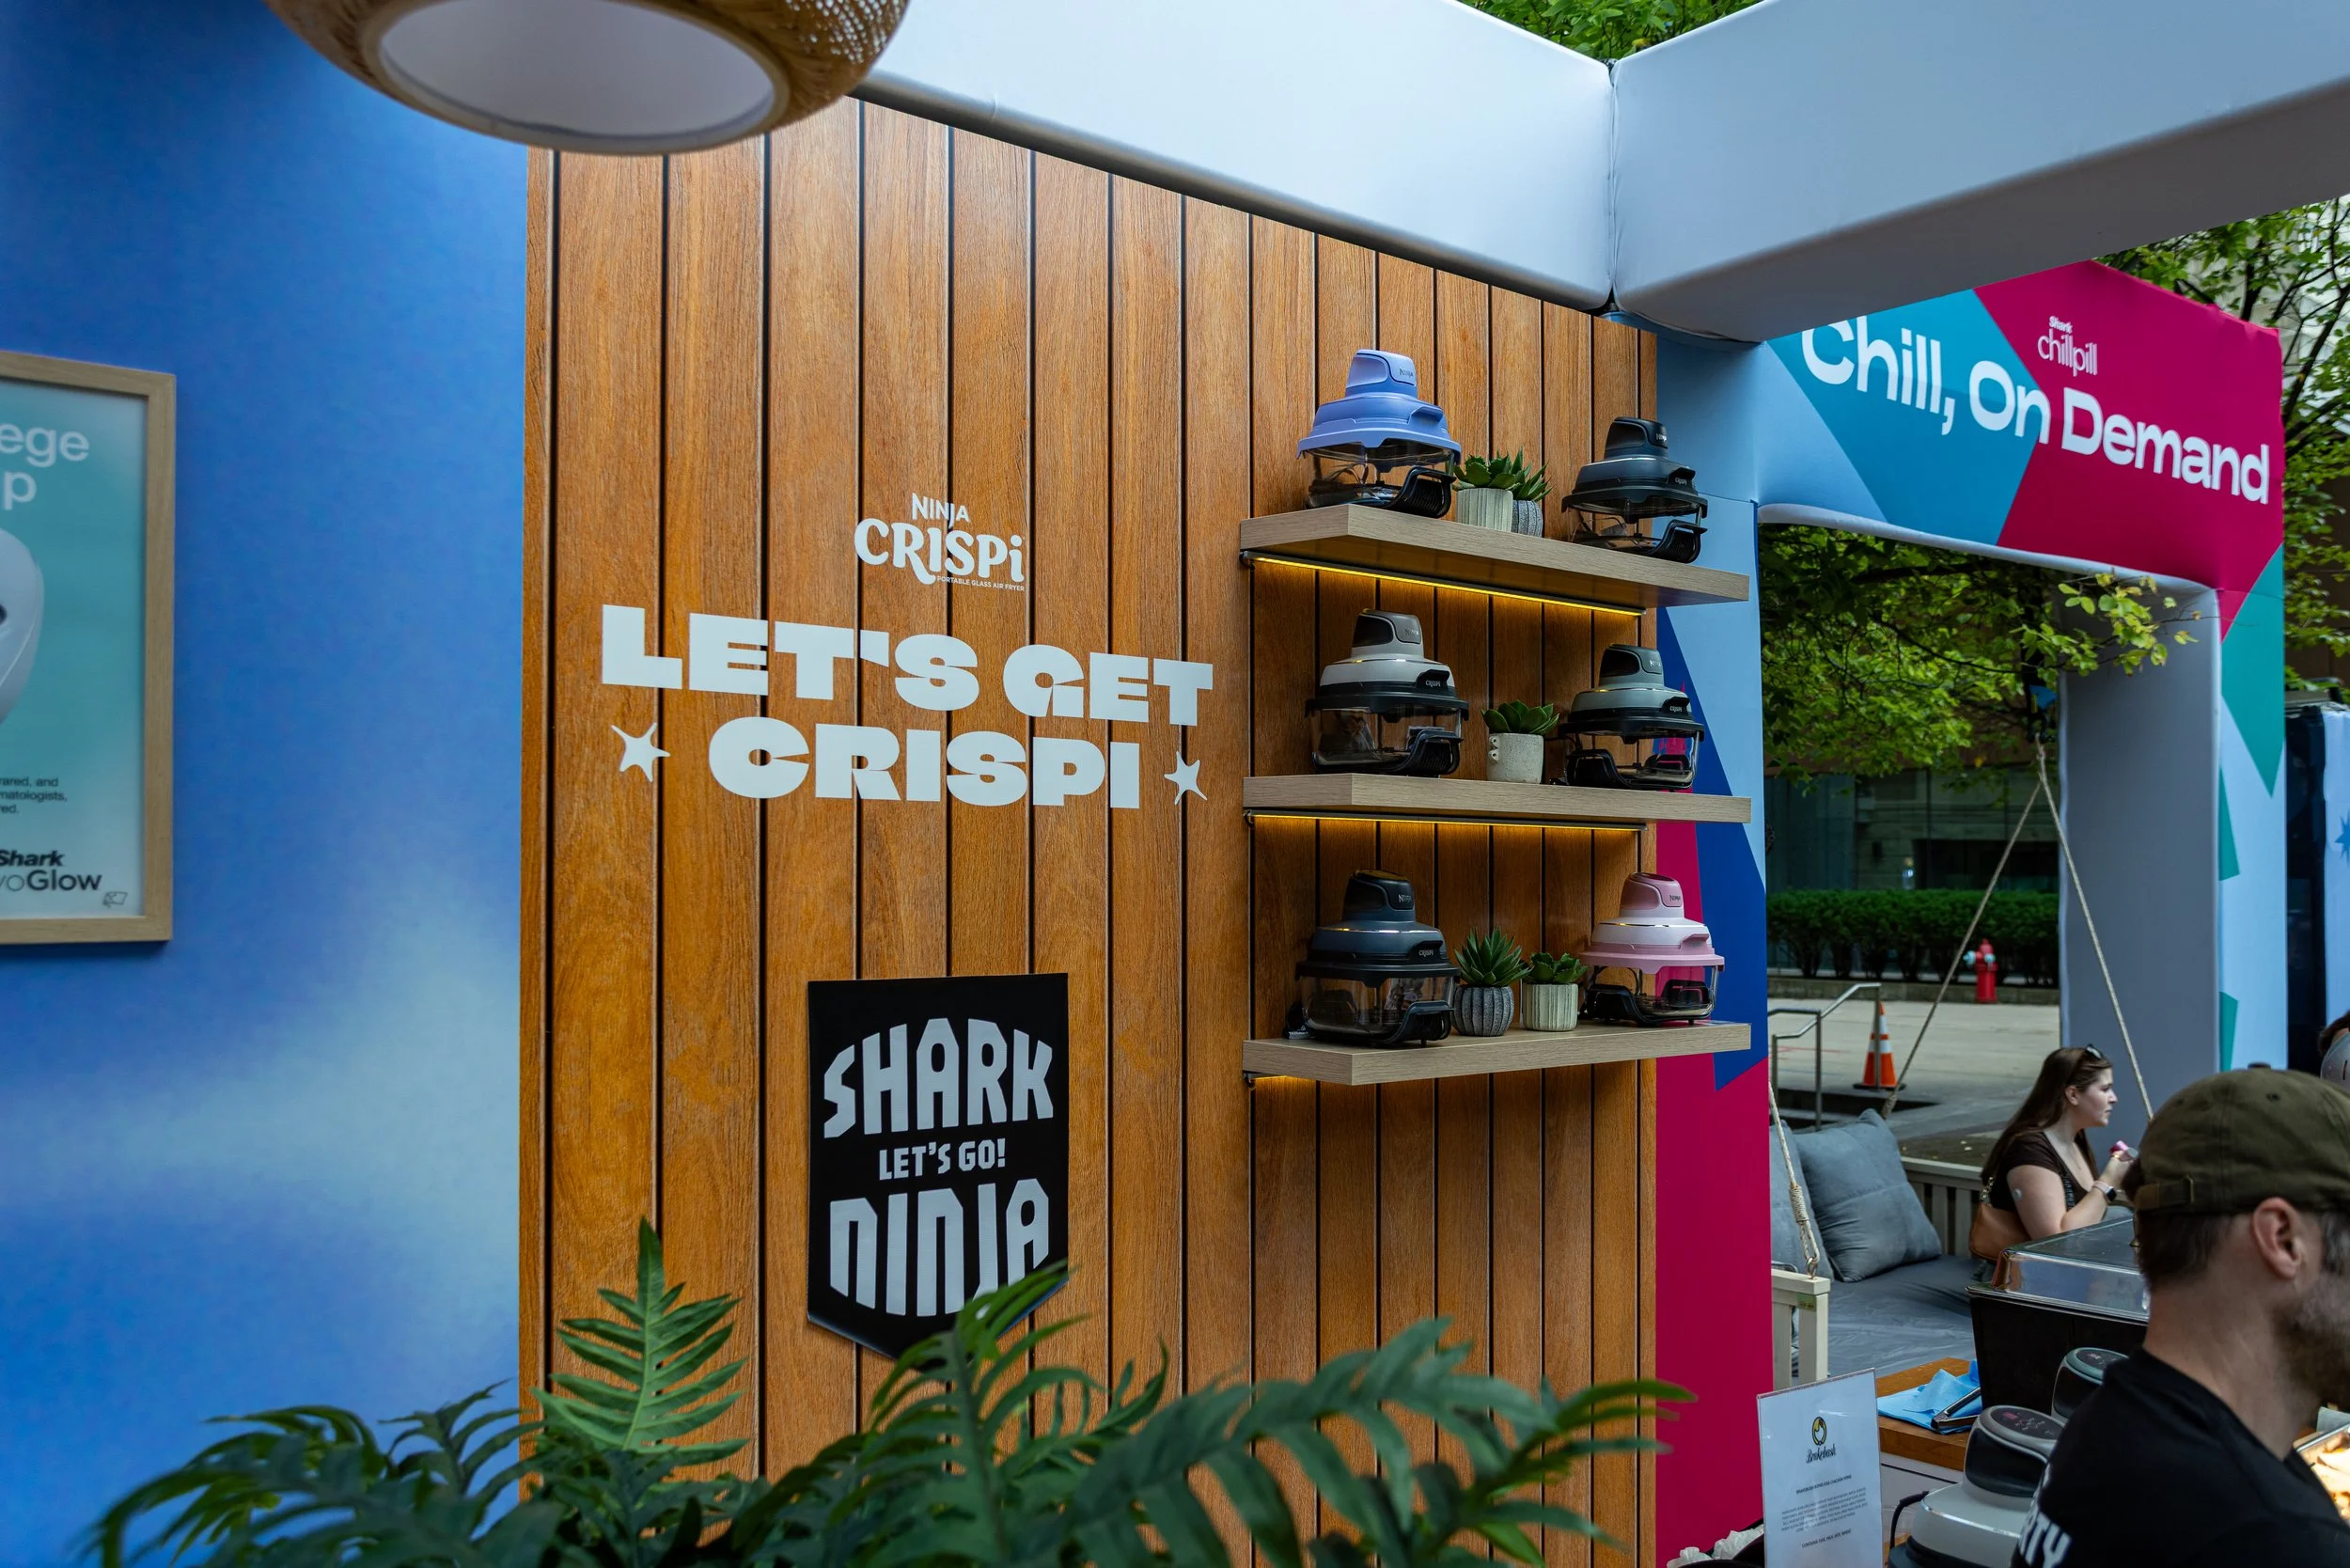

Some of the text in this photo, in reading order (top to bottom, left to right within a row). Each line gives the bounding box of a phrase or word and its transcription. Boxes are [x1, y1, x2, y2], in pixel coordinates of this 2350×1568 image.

[2049, 316, 2073, 334] Shark
[2037, 328, 2098, 377] chillpill
[1802, 315, 2271, 506] Chill, On Demand
[0, 423, 90, 468] ege
[4, 471, 38, 510] p
[912, 493, 970, 528] NINJA
[936, 575, 971, 586] PORTABLE
[601, 604, 1214, 727] LET'S GET
[36, 777, 59, 788] and
[709, 715, 1140, 809] CRISPI
[0, 849, 66, 867] Shark
[823, 1017, 1054, 1138] SHARK
[879, 1137, 1006, 1181] LET'S GO!
[829, 1178, 1050, 1317] NINJA
